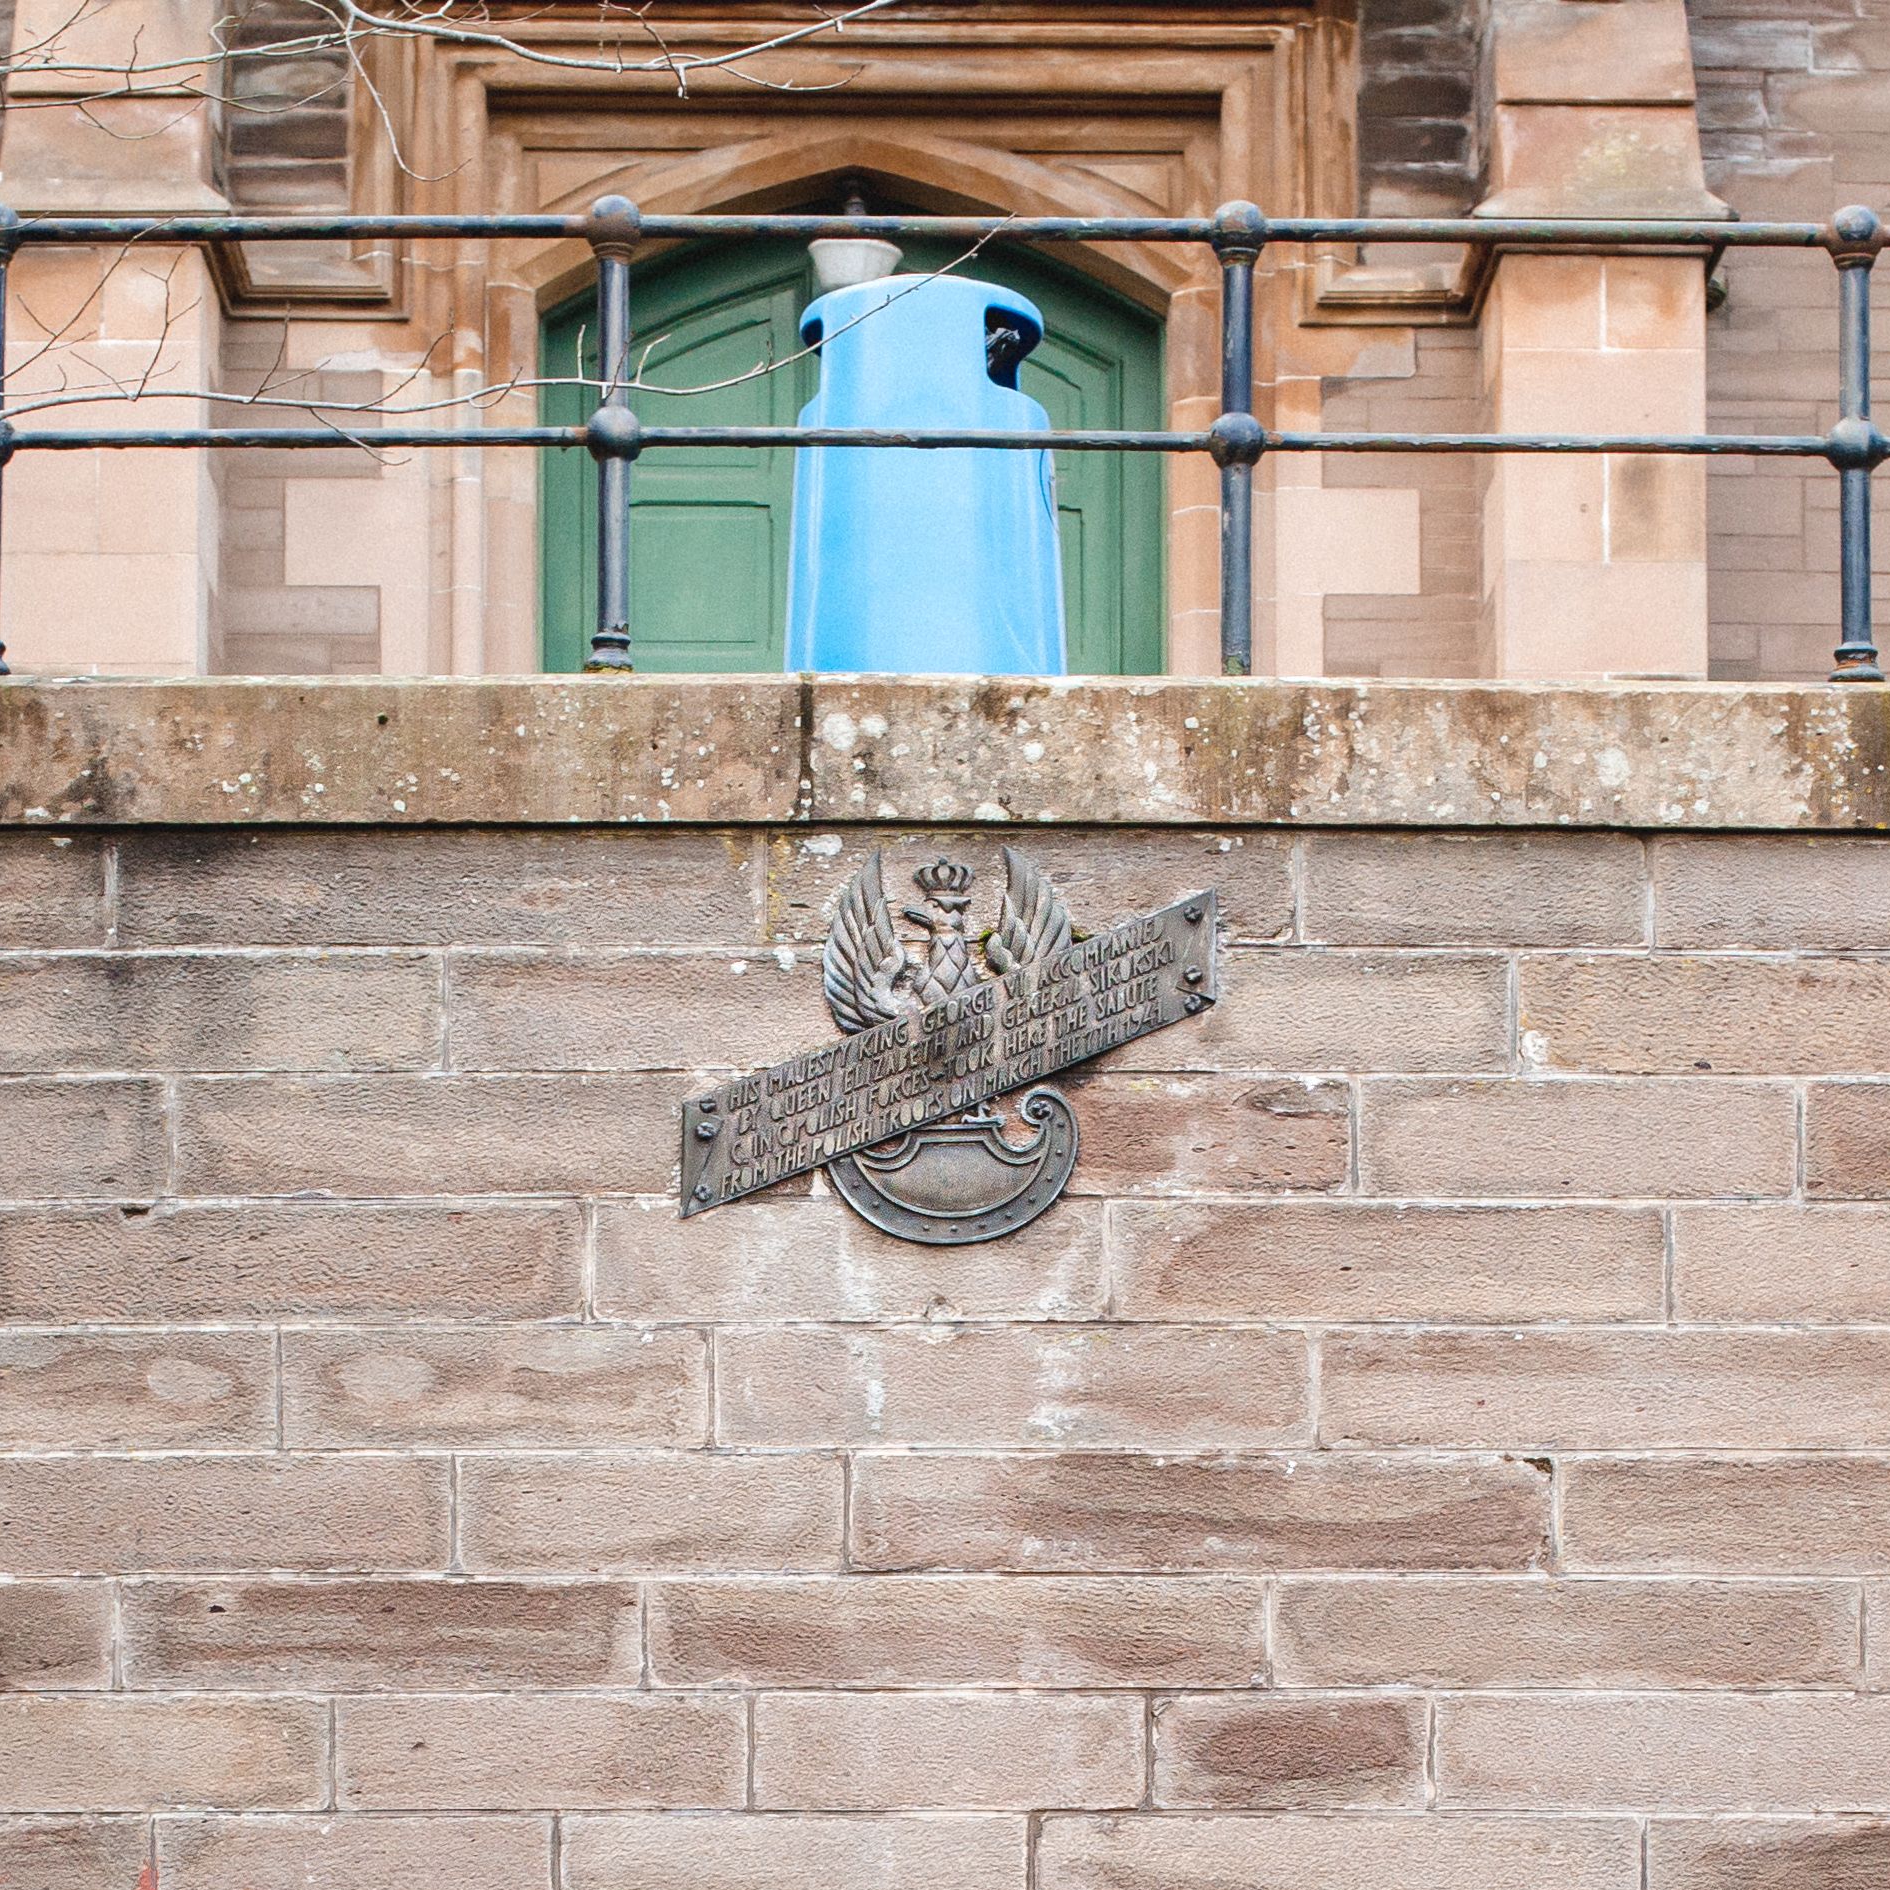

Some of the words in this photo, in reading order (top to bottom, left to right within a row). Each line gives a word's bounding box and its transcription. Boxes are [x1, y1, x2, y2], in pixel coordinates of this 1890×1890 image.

[720, 1158, 769, 1198] FROM
[775, 1142, 807, 1178] THE
[811, 1118, 874, 1164] POLISH
[879, 1090, 944, 1135] TROOPS
[949, 1079, 977, 1108] ON
[982, 1048, 1043, 1093] MARCH
[1050, 1034, 1080, 1068] THE
[1123, 999, 1164, 1039] 1941
[729, 1079, 760, 1111] HIS
[767, 1043, 851, 1097] MAJESTY
[859, 1017, 908, 1060] KING
[921, 985, 994, 1034] GEORGE
[1038, 918, 1163, 990] ACCOMPANIED
[738, 1105, 761, 1135] BY
[769, 1078, 832, 1121] QUEEN
[843, 1031, 947, 1095] ELIZABETH
[956, 1013, 995, 1049] AND
[1001, 980, 1082, 1030] GENERAL
[1090, 940, 1175, 996] SIKORSKI
[751, 1133, 773, 1158] IN
[794, 1091, 858, 1143] POLISH
[1003, 1019, 1048, 1060] HERE
[1054, 1003, 1088, 1039] THE
[1095, 975, 1159, 1021] SALUTE
